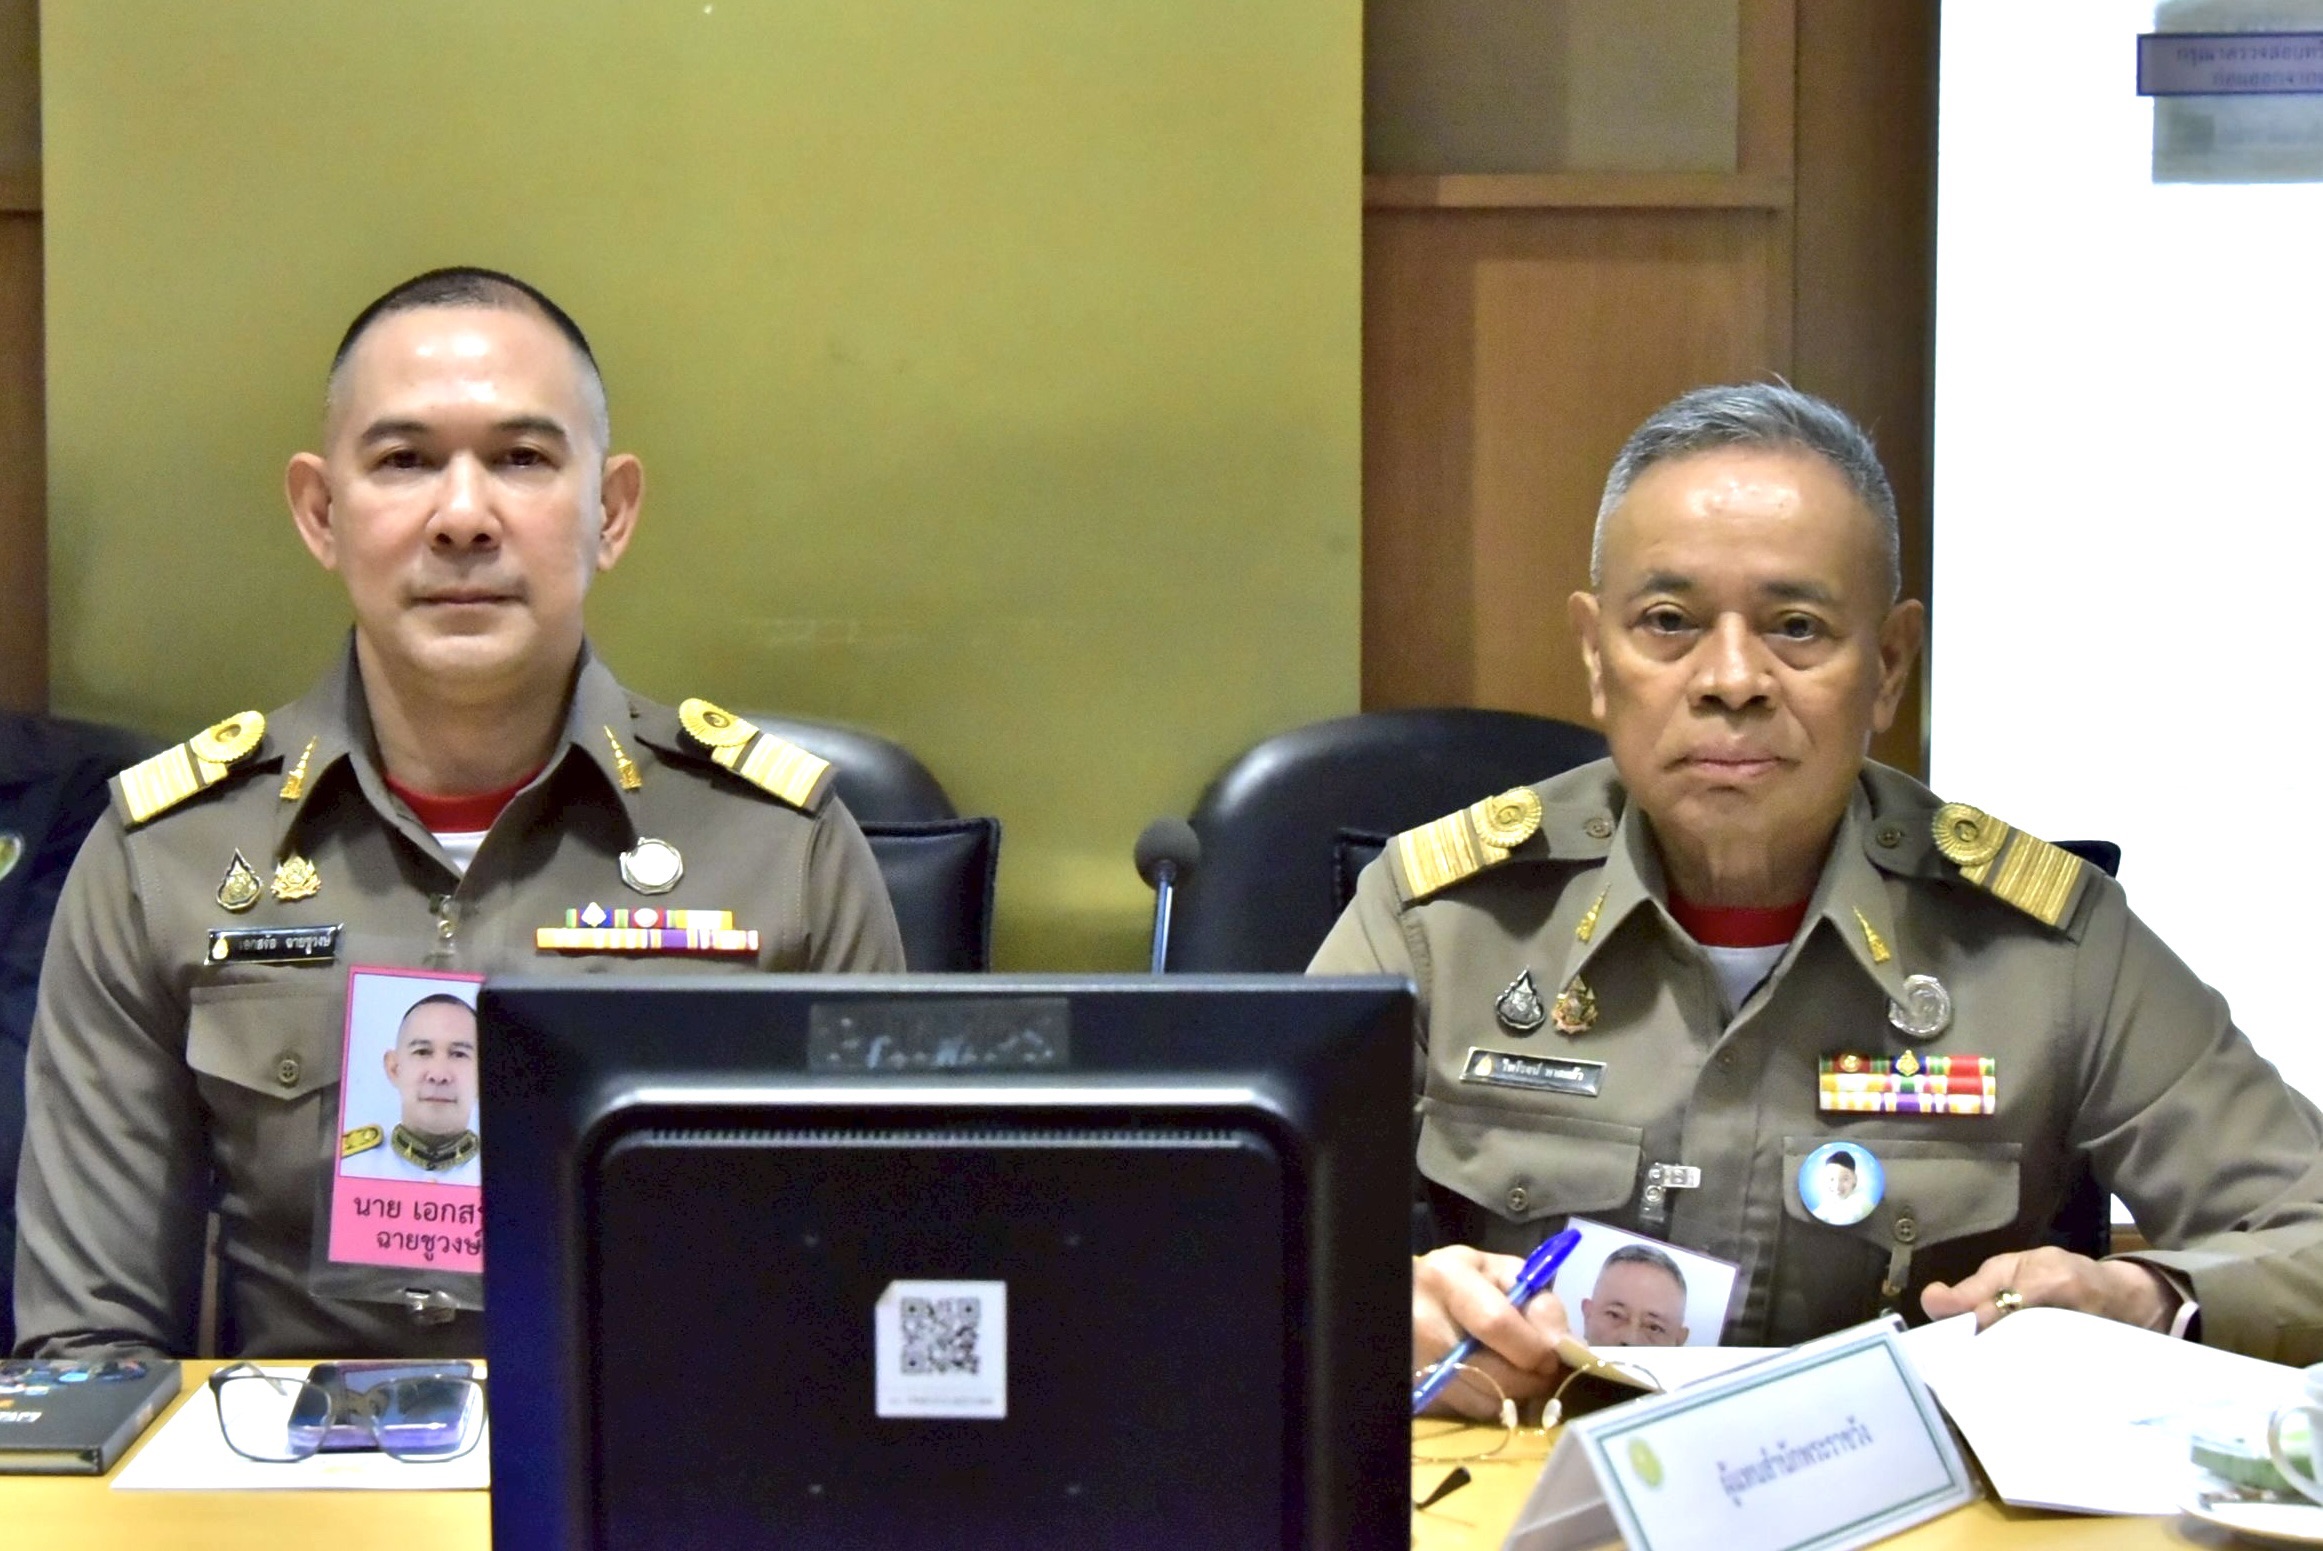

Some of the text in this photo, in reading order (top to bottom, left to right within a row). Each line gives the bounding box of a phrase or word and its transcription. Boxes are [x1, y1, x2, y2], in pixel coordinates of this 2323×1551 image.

[353, 1196, 401, 1218] นาย
[376, 1228, 482, 1262] ฉายชูวงษ์
